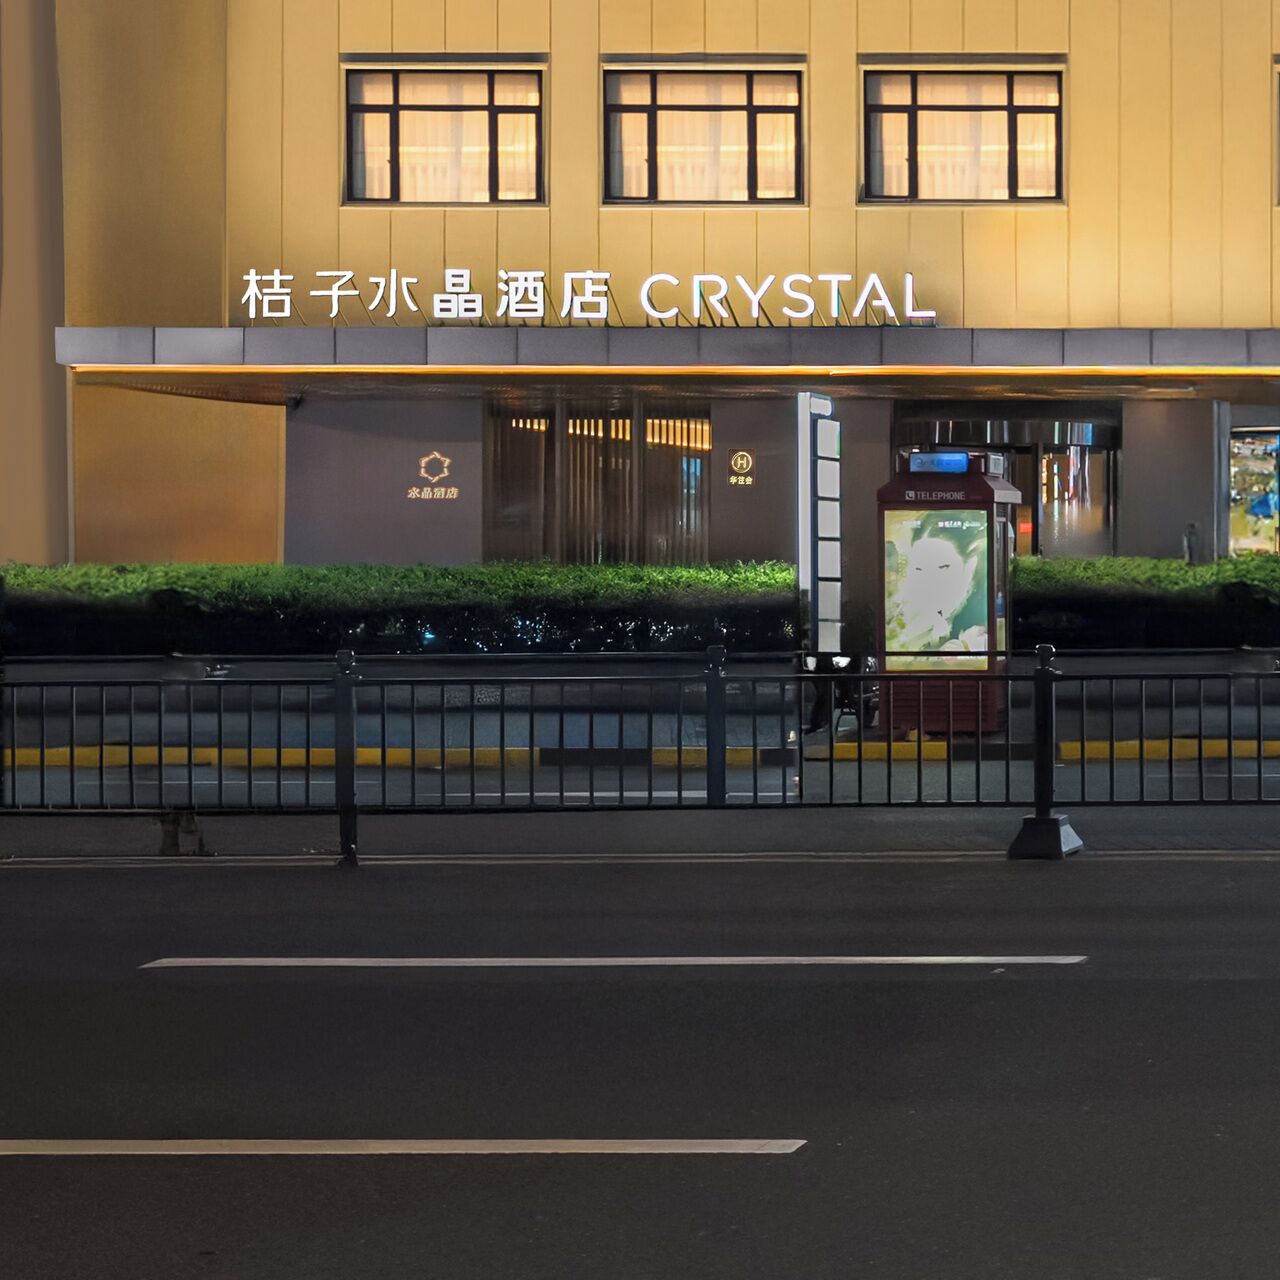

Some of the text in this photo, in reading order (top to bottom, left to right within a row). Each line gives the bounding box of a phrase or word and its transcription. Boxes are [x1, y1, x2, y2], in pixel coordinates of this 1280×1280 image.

[241, 269, 936, 319] 桔子水晶酒店 CRYSTAL
[407, 486, 460, 499] 水晶酒店
[916, 491, 966, 500] TELEPHONE
